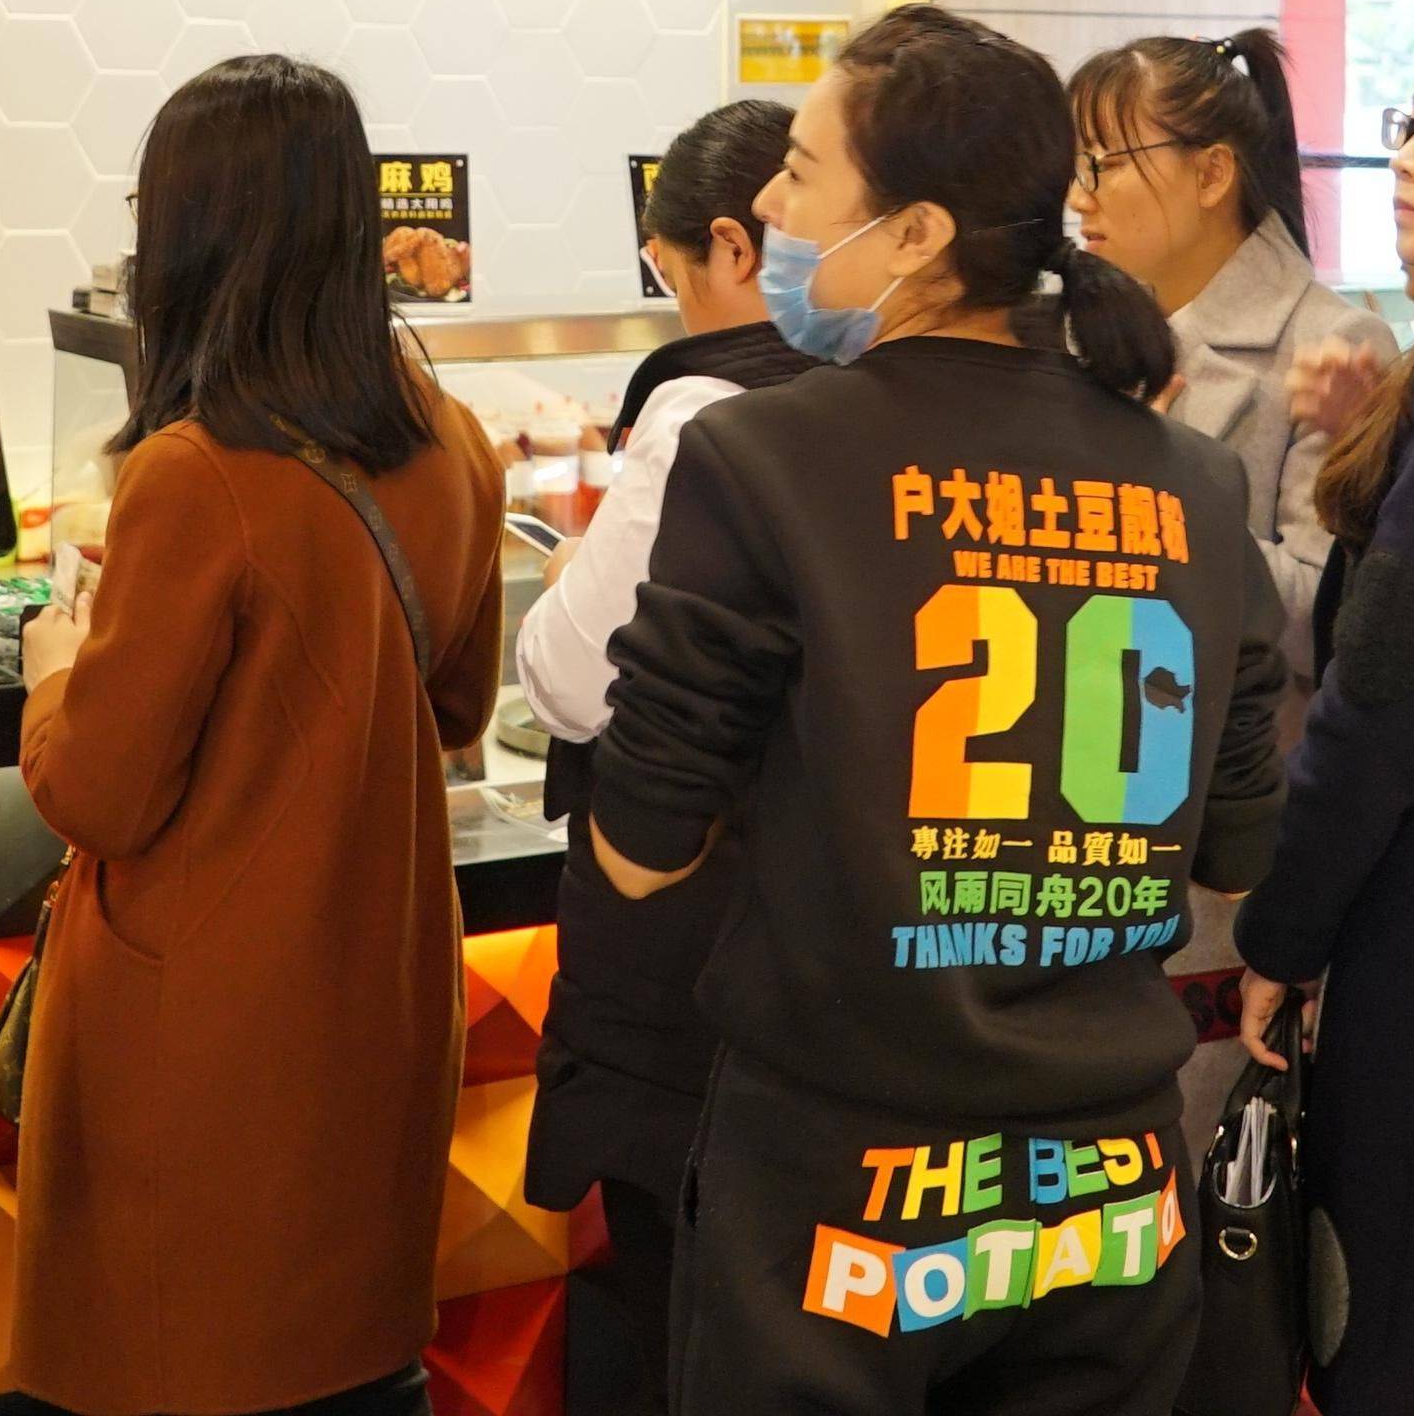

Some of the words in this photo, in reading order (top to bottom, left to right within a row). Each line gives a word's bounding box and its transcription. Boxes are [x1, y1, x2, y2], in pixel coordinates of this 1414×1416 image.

[953, 550, 993, 578] WE
[996, 554, 1041, 582] ARE
[1046, 558, 1091, 585] THE
[1095, 561, 1159, 591] BEST
[908, 584, 1195, 825] 20
[891, 922, 1028, 970] THANKS
[1039, 926, 1115, 967] FOR
[1120, 913, 1181, 955] YOU
[861, 1133, 1003, 1221] THE
[821, 1189, 1178, 1320] POTATO
